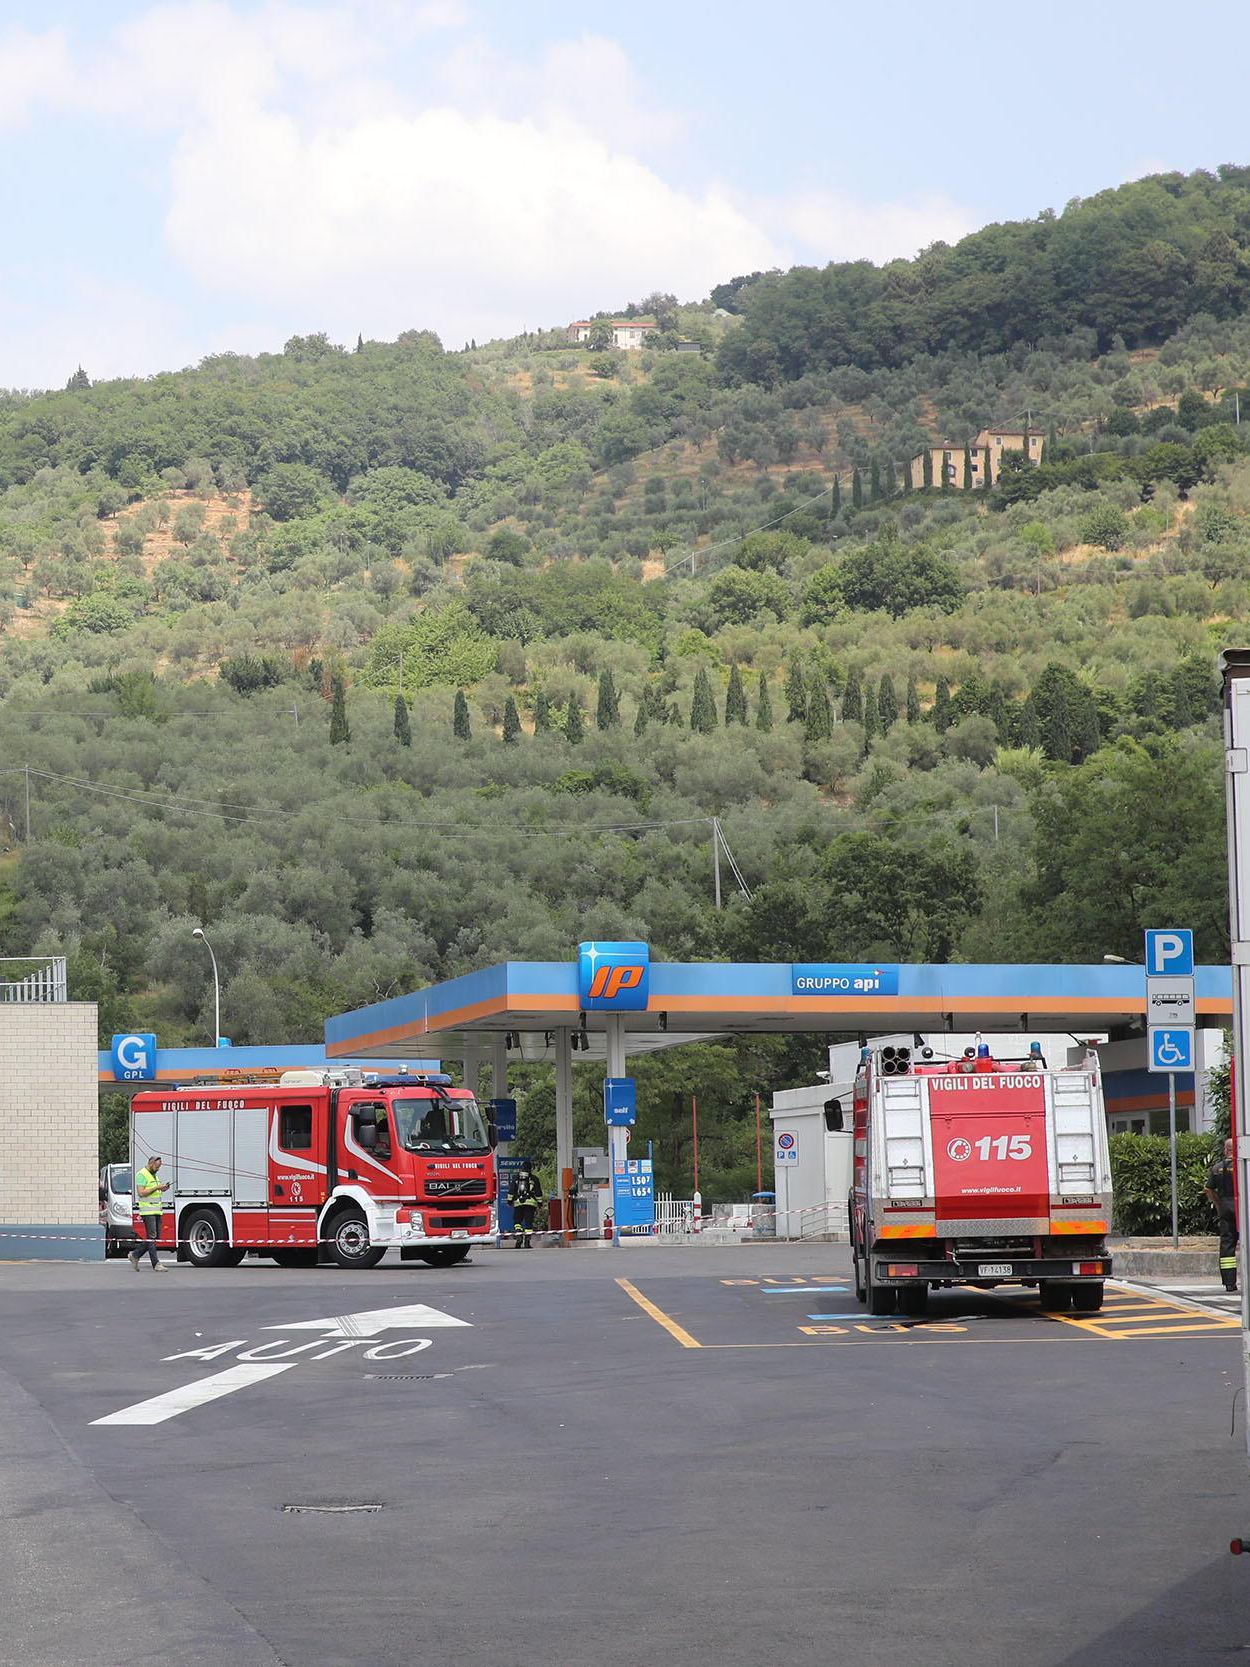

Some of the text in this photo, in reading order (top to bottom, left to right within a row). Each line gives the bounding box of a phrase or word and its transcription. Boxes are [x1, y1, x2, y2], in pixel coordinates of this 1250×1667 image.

[1154, 934, 1184, 972] P
[588, 965, 645, 999] IP
[796, 976, 880, 992] GRUPPO api
[117, 1036, 147, 1070] G
[123, 1070, 145, 1079] GPL
[931, 1075, 1041, 1091] VIGILI DEL FUOCO
[162, 1099, 245, 1111] VIGILI DEL FUOCO
[975, 1134, 1033, 1161] 115
[796, 1323, 968, 1335] BUS
[159, 1338, 434, 1361] AUTO
